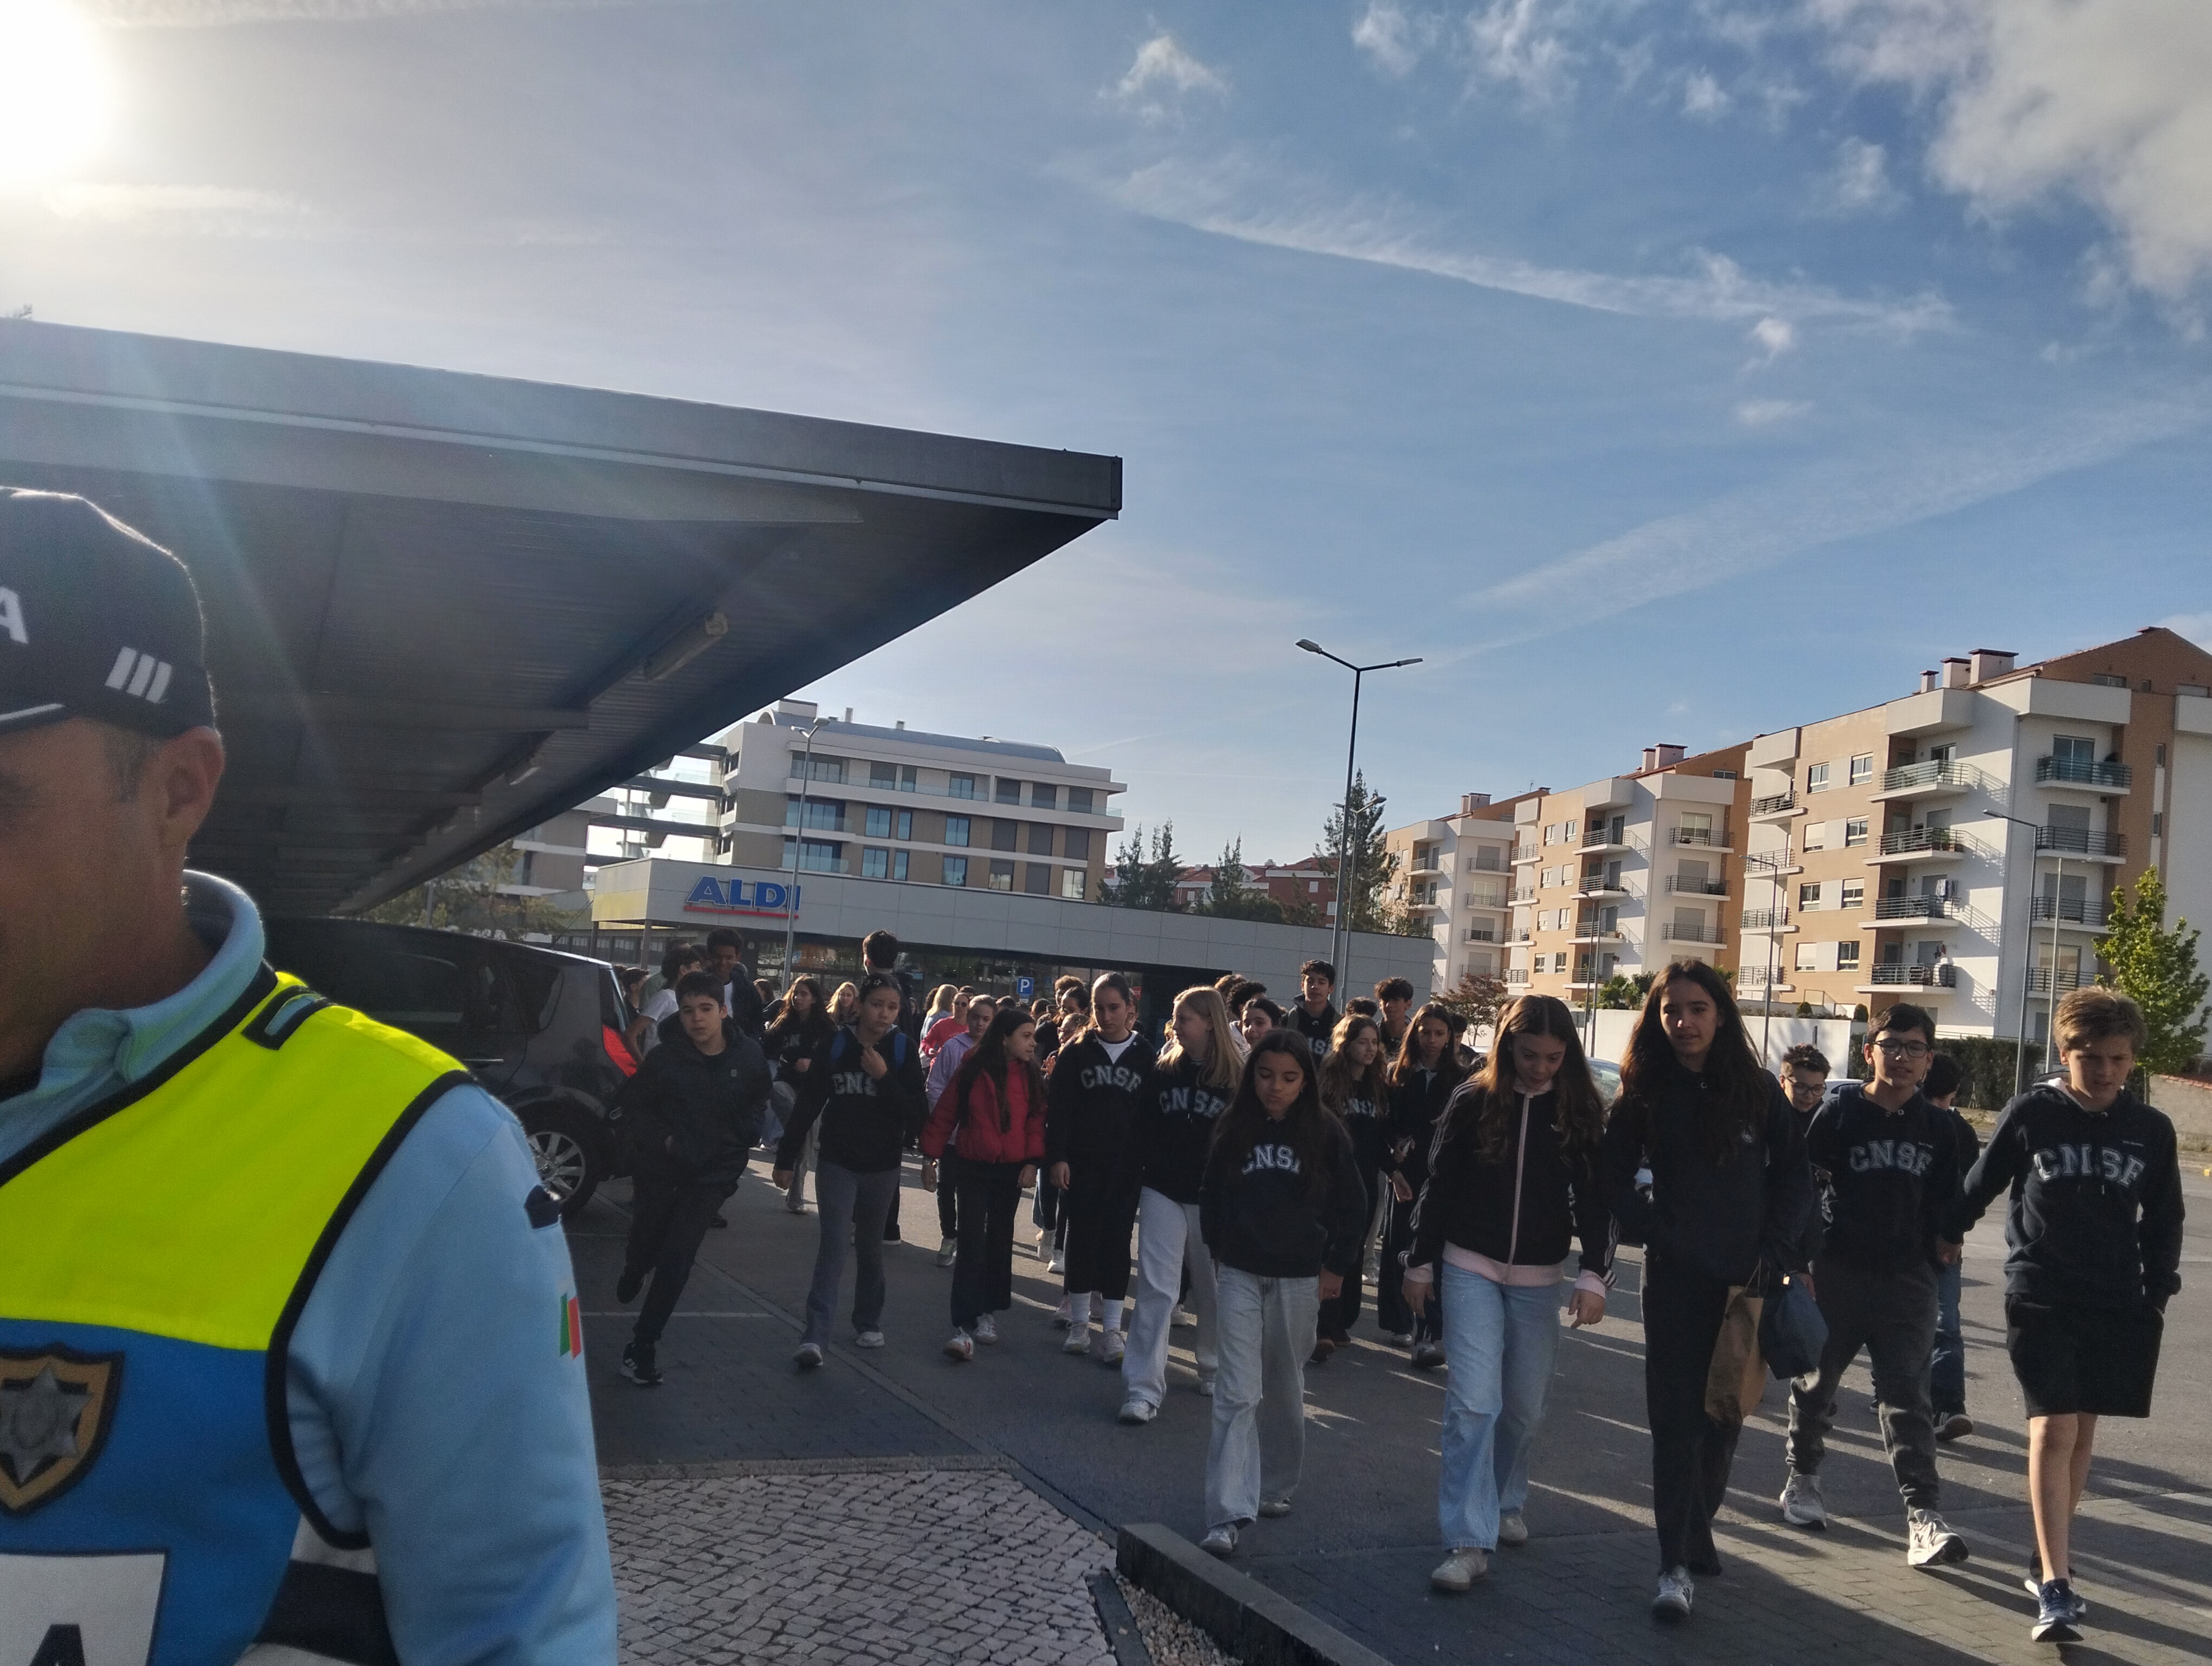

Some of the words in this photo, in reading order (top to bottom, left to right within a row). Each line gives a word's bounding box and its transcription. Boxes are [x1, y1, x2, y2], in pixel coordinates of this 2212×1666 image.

[686, 875, 802, 911] ALDI
[1020, 979, 1030, 992] P
[1081, 1065, 1141, 1093] CNSF
[1159, 1087, 1226, 1118] CNSF
[1849, 1139, 1933, 1176] CNSF
[2033, 1144, 2145, 1188] CNSF
